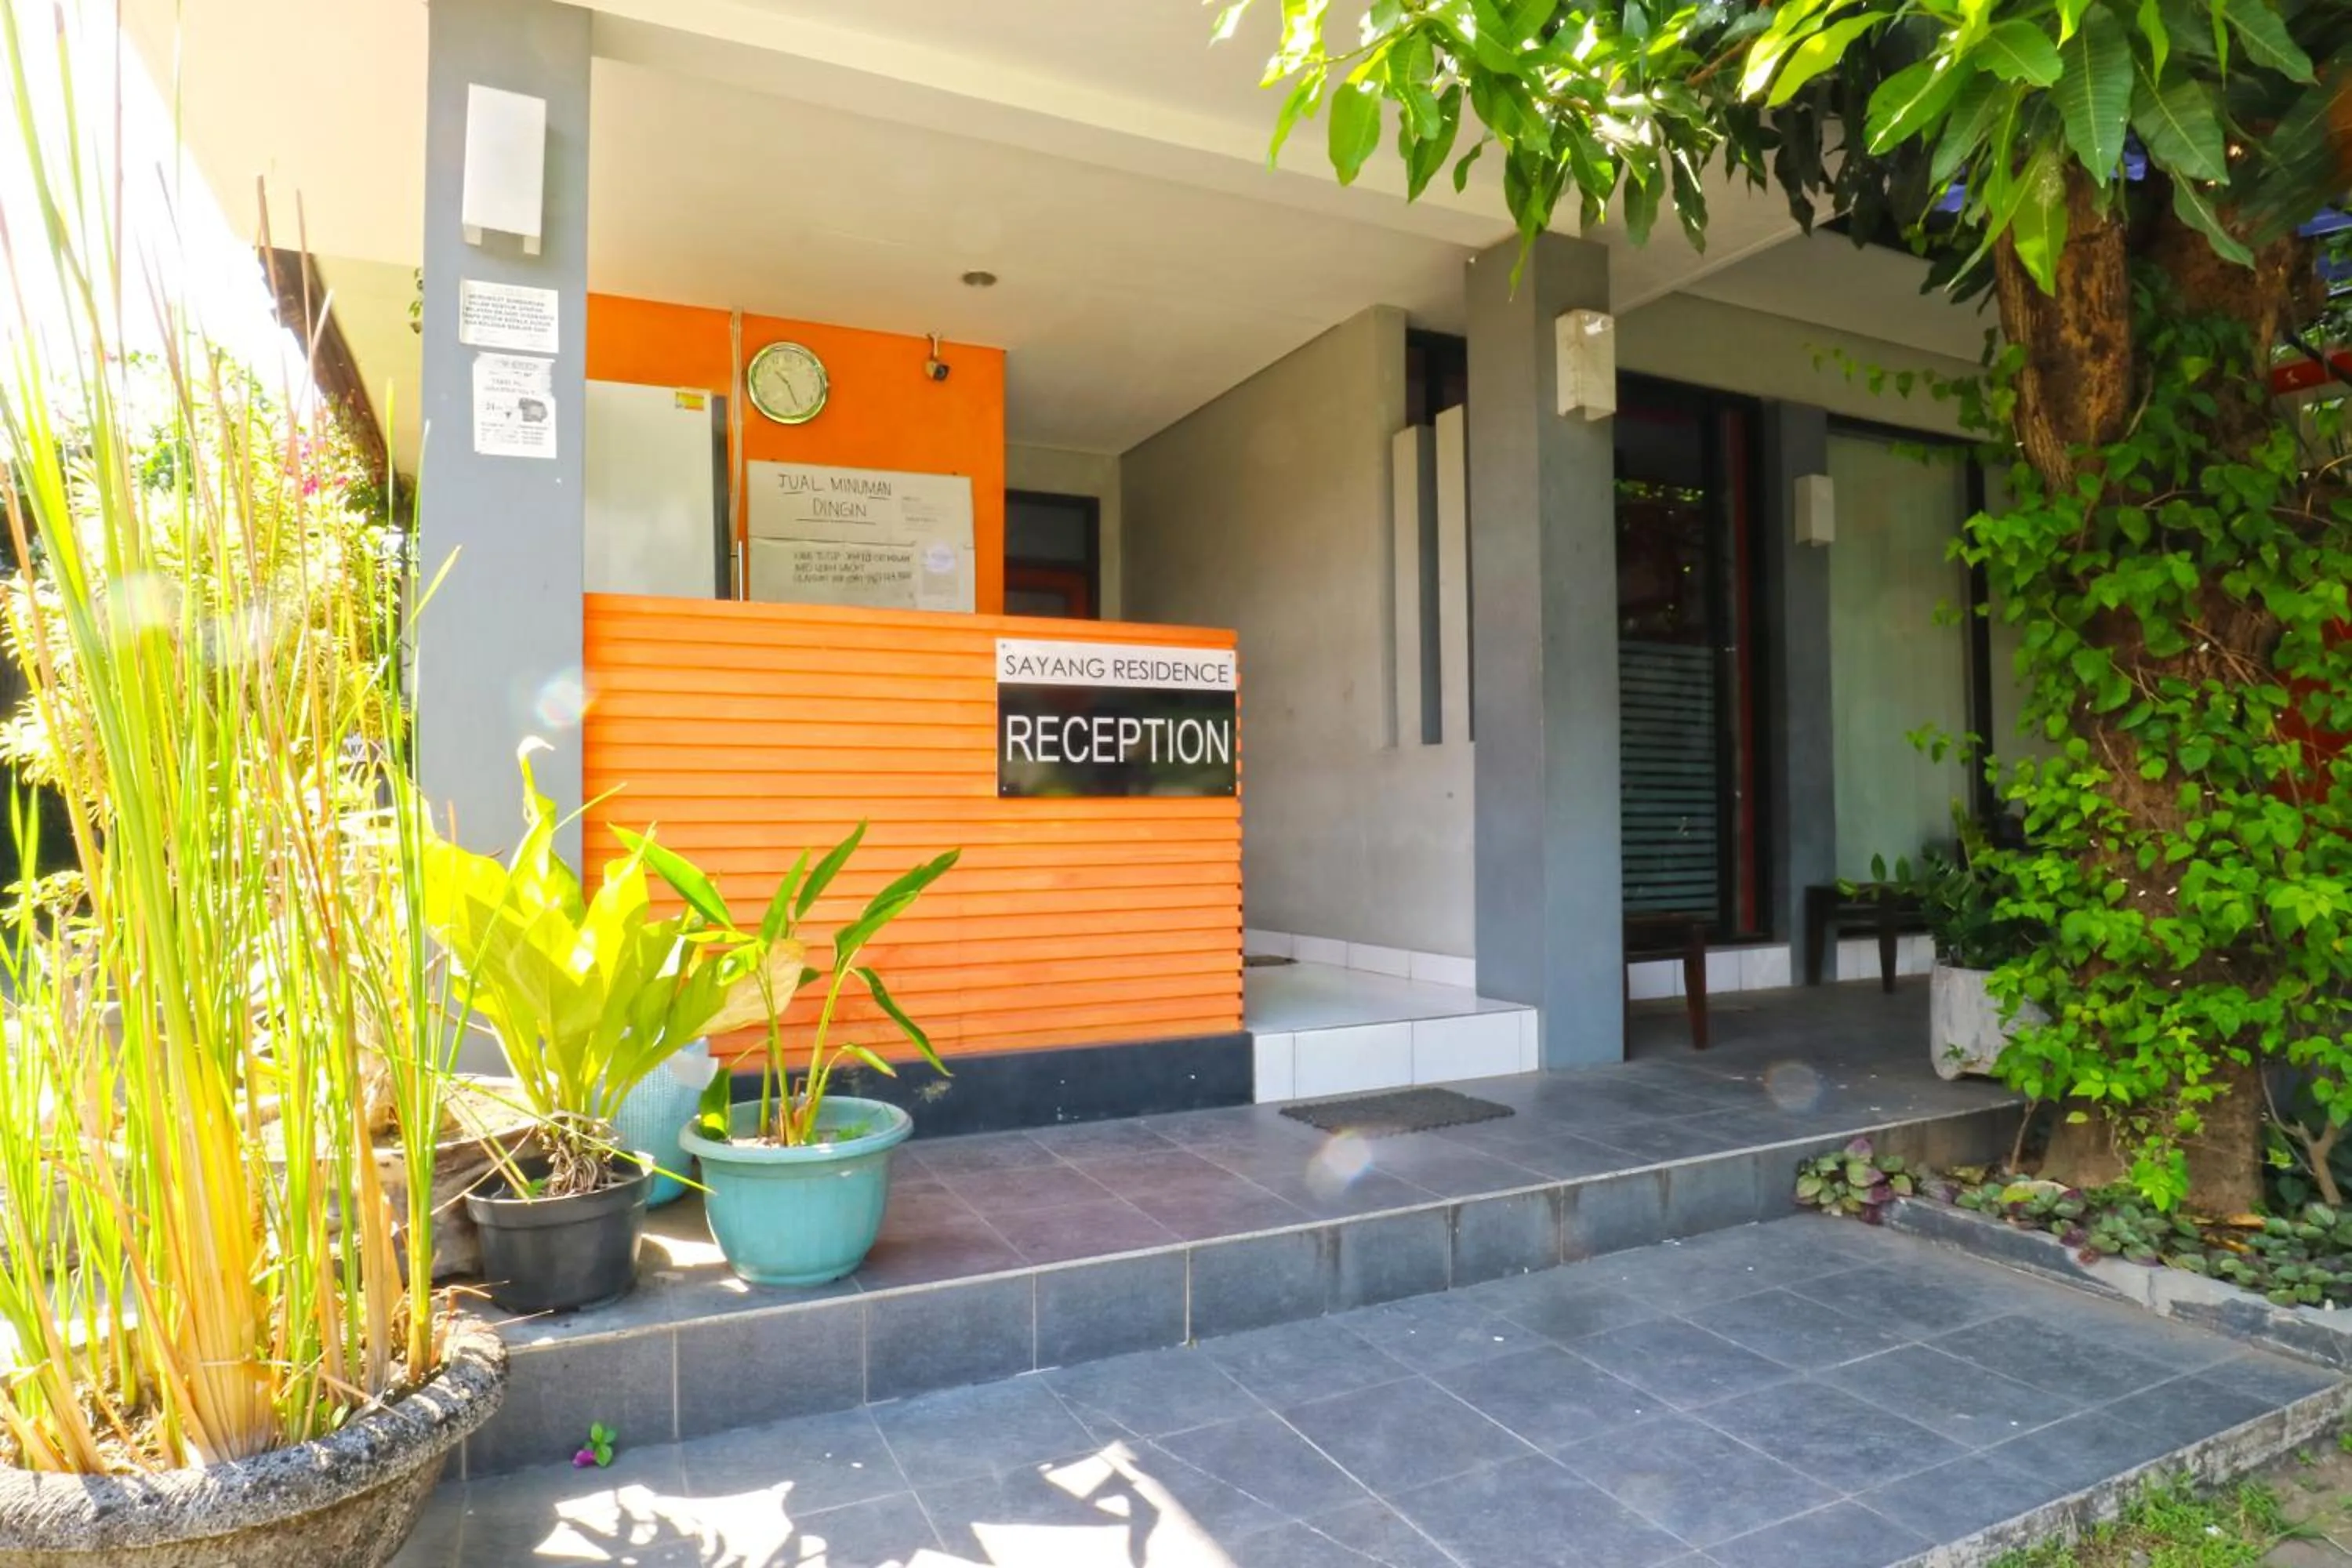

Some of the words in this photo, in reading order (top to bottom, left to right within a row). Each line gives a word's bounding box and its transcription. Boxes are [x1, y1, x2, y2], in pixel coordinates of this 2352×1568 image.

[777, 474, 824, 492] JUAL
[830, 477, 892, 496] MINUMAN
[812, 497, 867, 517] DINGIN
[1005, 655, 1105, 678] SAYANG
[1113, 659, 1229, 684] RESIDENCE
[1006, 714, 1229, 764] RECEPTION
